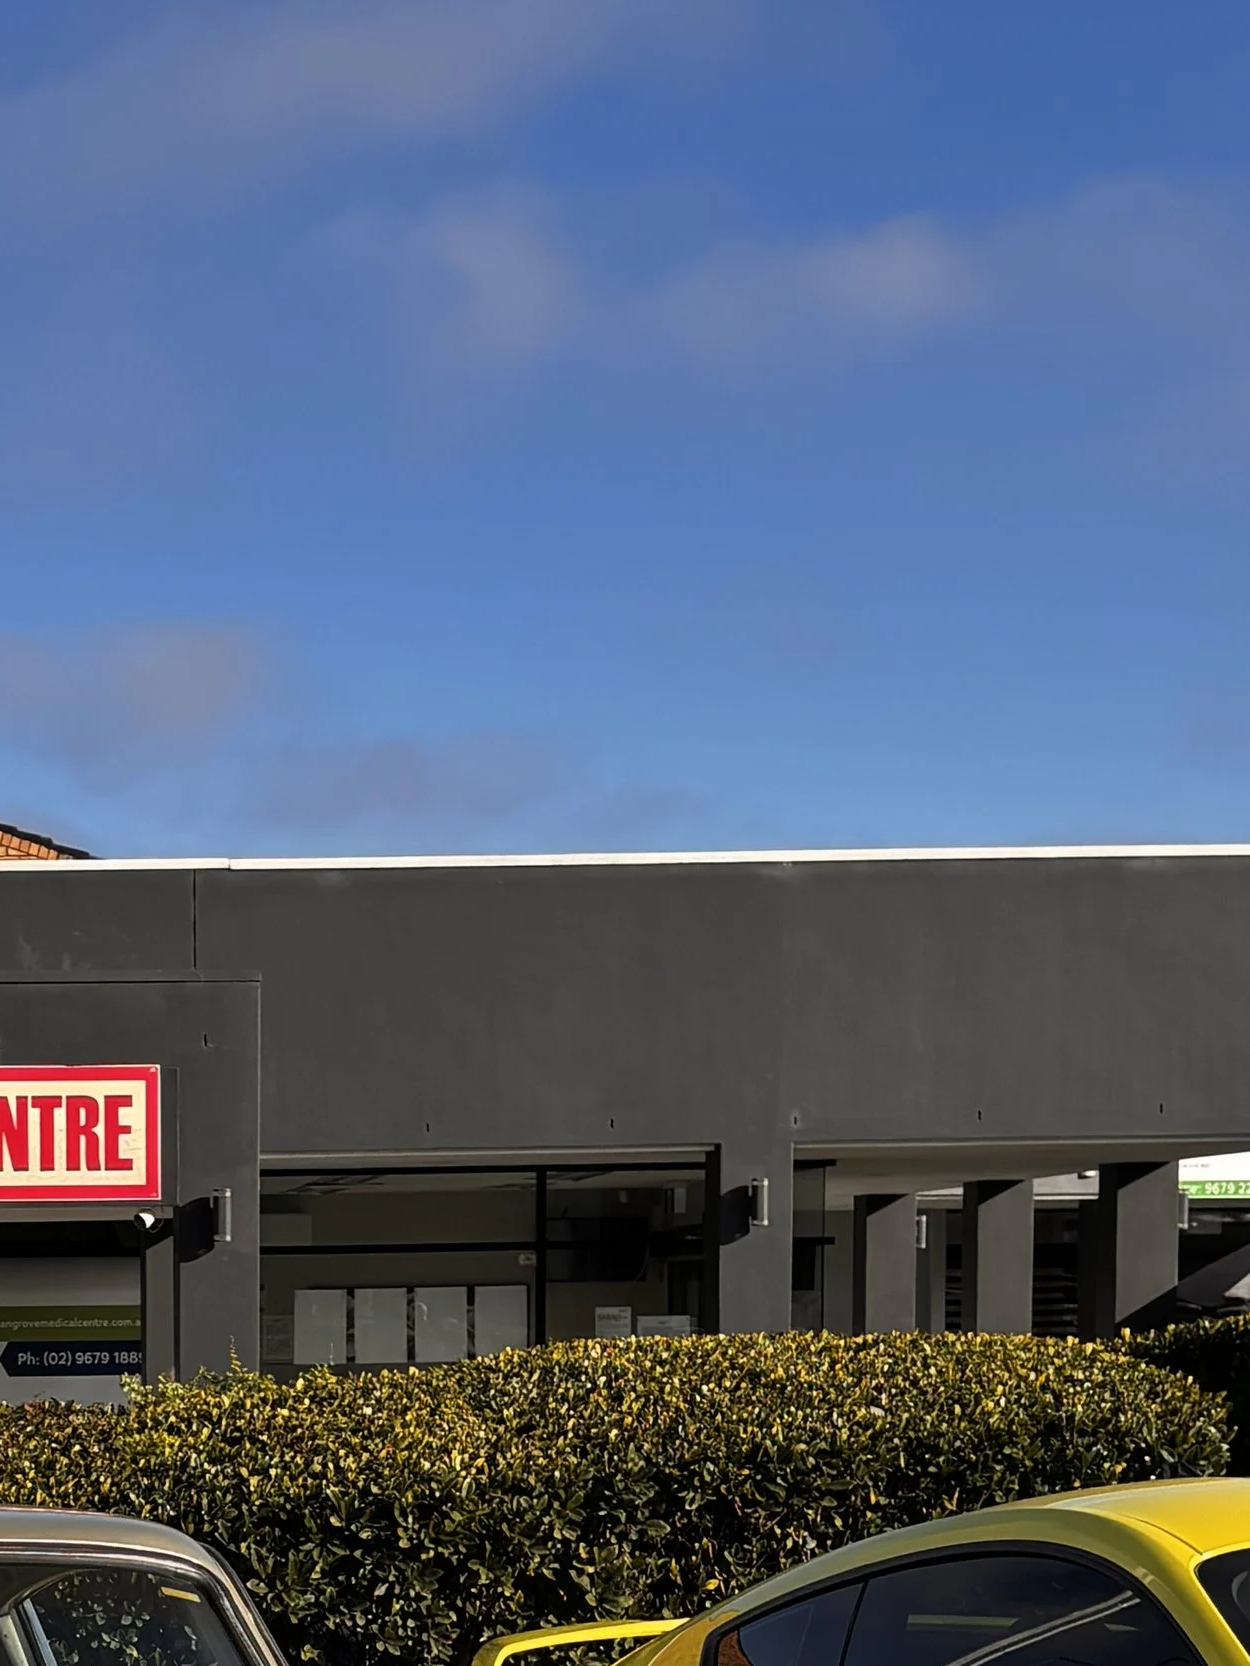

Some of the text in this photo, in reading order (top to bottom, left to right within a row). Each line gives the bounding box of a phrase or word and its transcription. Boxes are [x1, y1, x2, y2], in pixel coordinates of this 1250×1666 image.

[17, 1353, 40, 1366] Ph:
[43, 1351, 72, 1367] (02)
[75, 1352, 109, 1365] 9679
